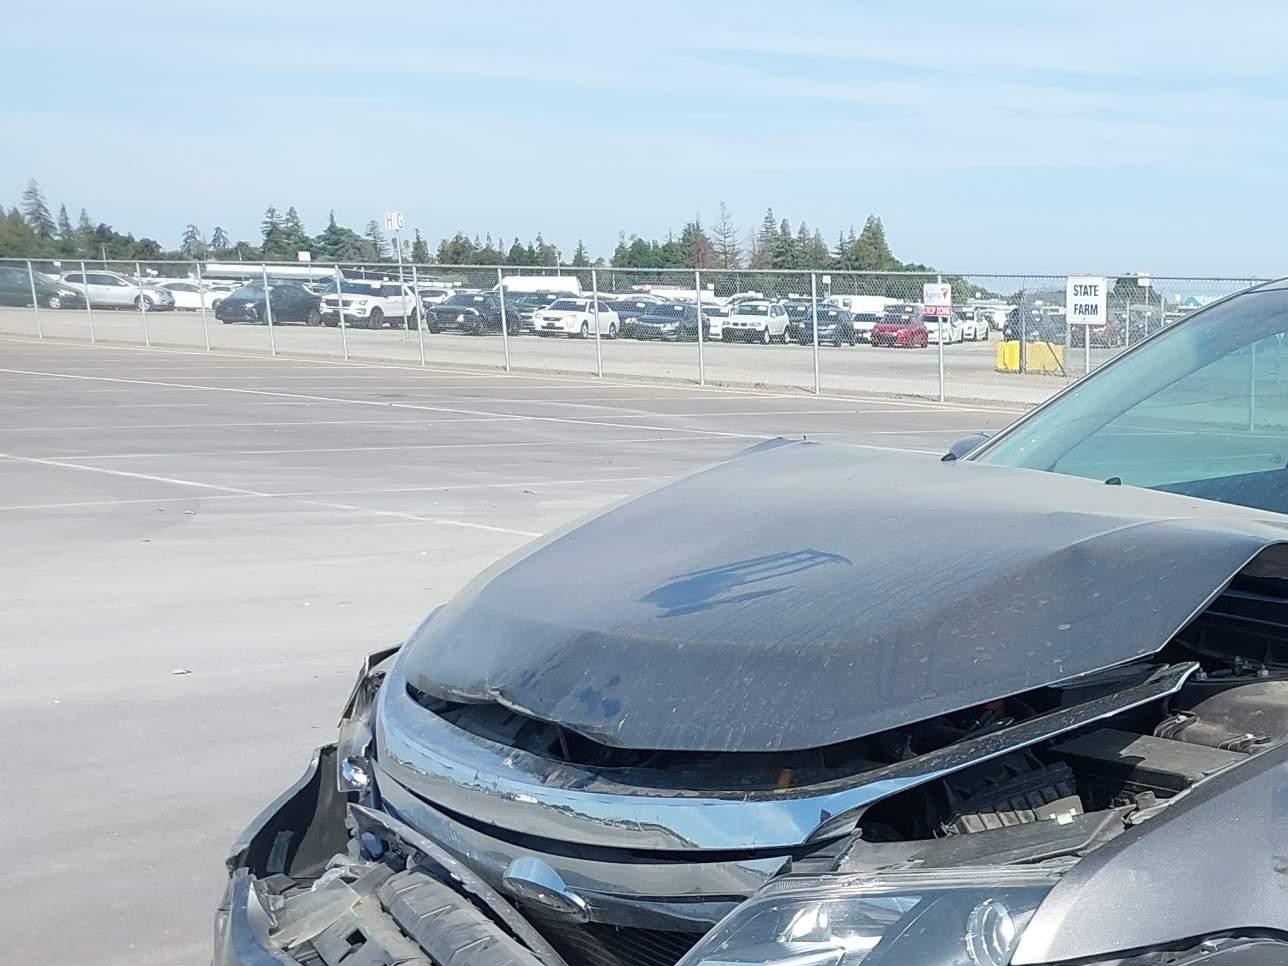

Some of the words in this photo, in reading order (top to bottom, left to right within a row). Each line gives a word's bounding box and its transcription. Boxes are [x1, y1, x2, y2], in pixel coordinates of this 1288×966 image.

[386, 213, 393, 228] H
[397, 212, 403, 228] G
[1073, 284, 1099, 297] STATE
[1073, 304, 1098, 315] FARM
